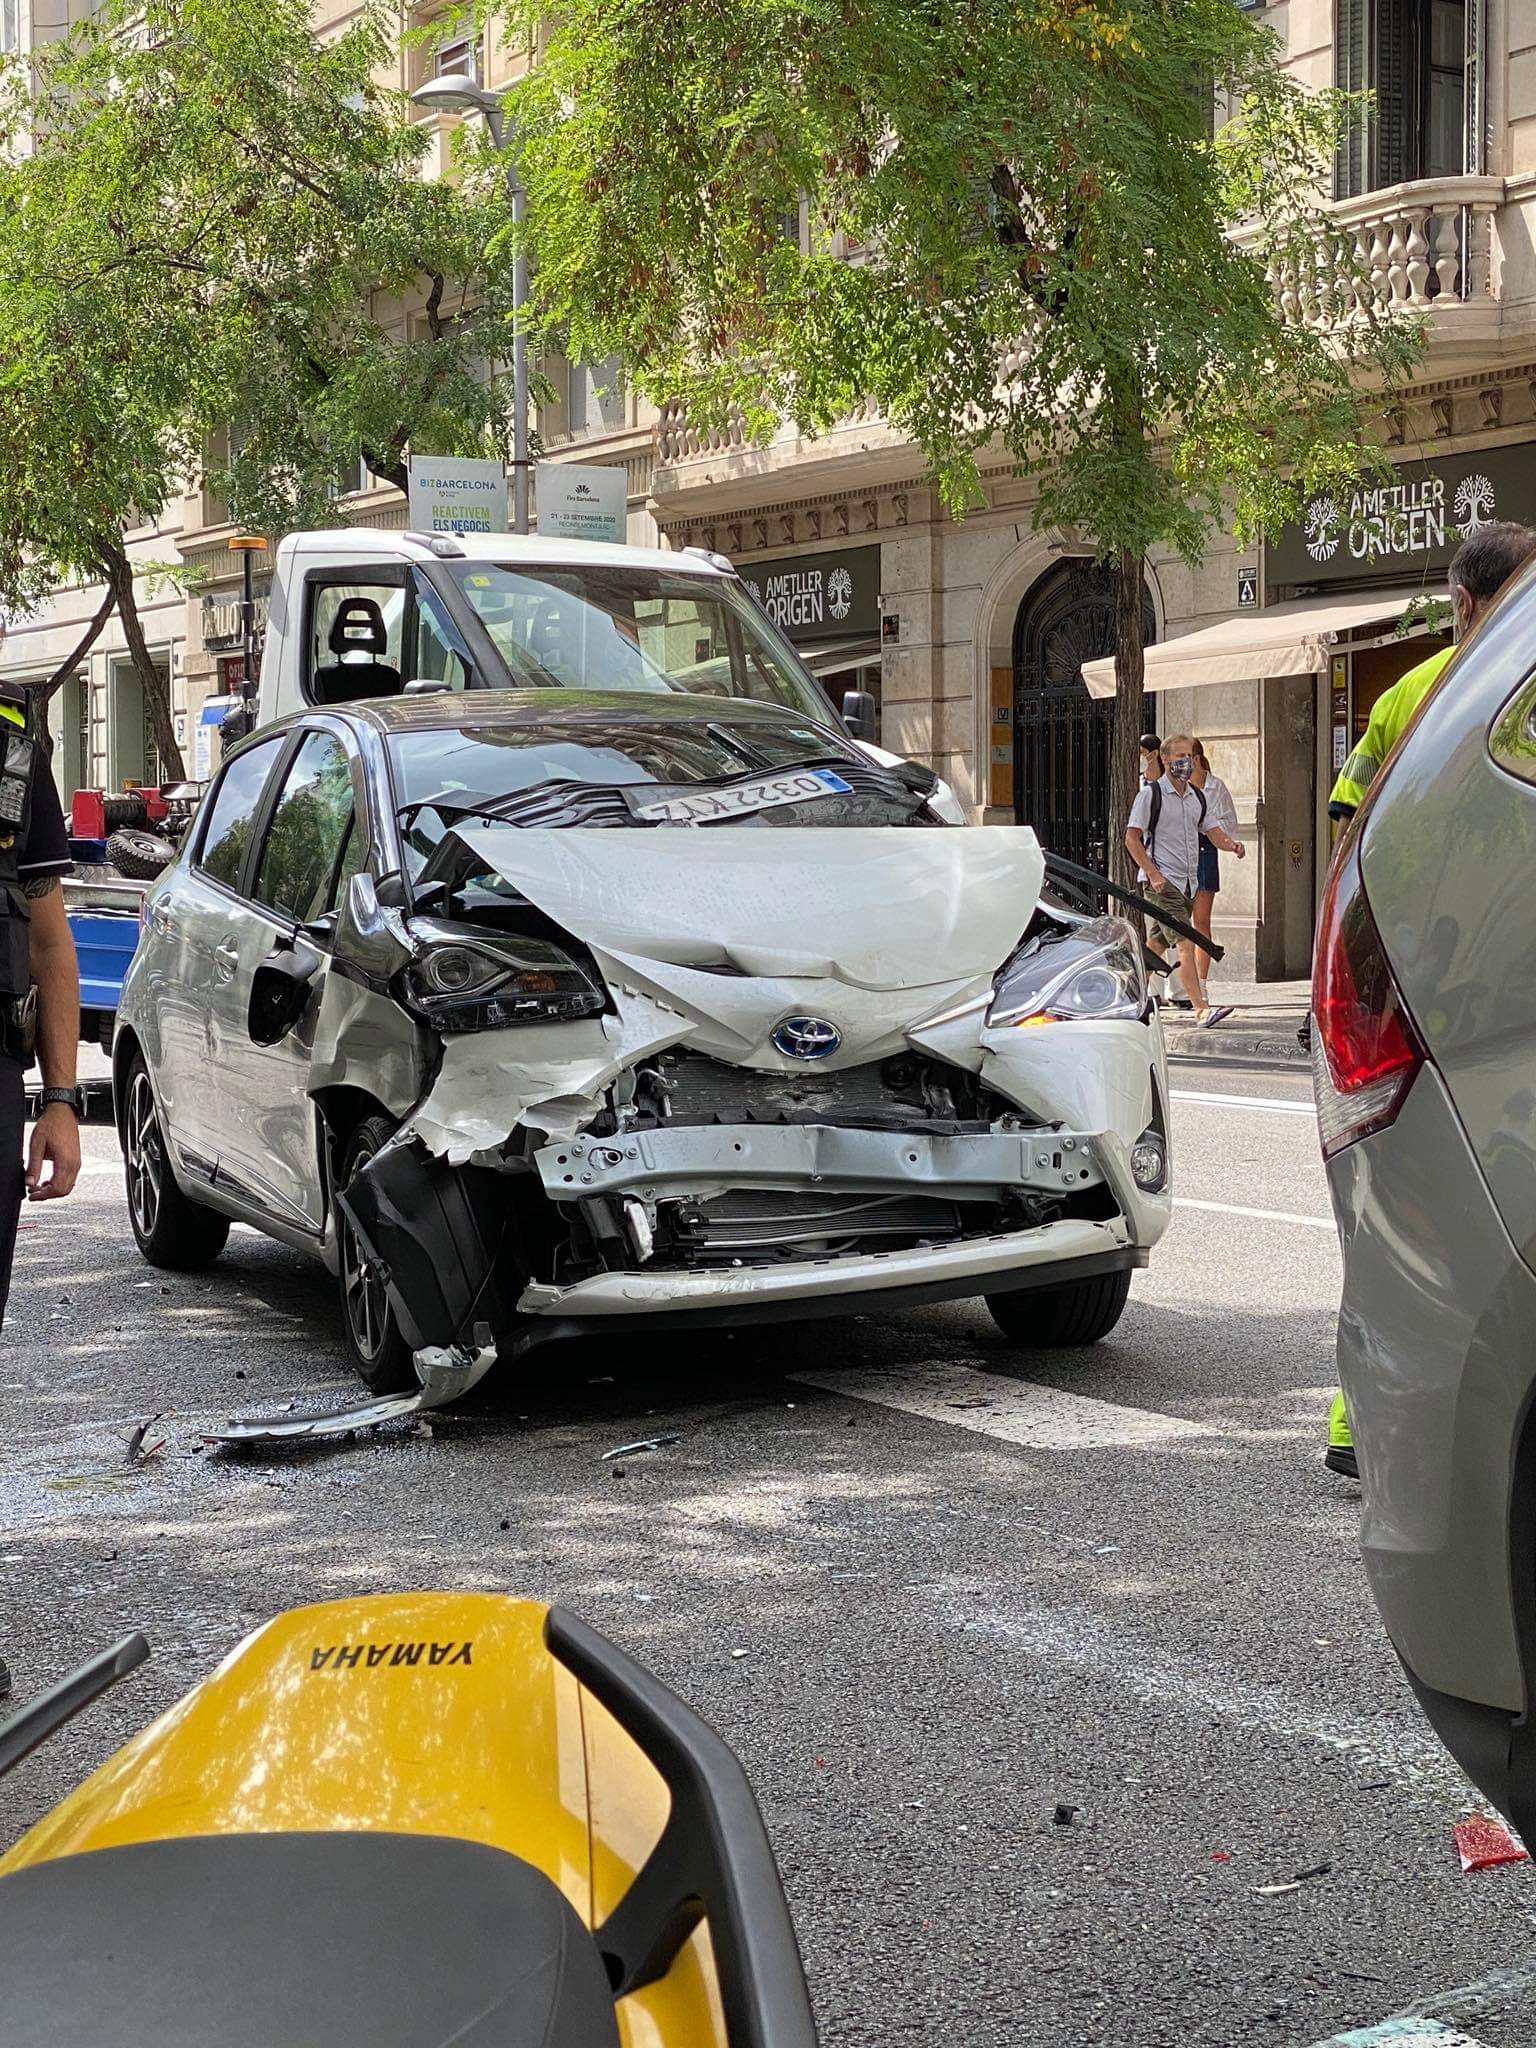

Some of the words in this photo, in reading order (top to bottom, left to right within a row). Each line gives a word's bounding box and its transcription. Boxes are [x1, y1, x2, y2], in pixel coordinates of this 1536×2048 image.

[420, 479, 497, 490] BIZBARCELONA
[1349, 479, 1445, 519] AMETLLER
[432, 505, 490, 519] REACTIVEM
[433, 519, 449, 531] ELS
[451, 520, 490, 532] NEGOCIS
[1349, 507, 1445, 559] ORIGEN
[765, 570, 822, 598] AMETLLER
[765, 592, 823, 626] ORIGEN
[310, 1641, 473, 1671] YAMAHA
